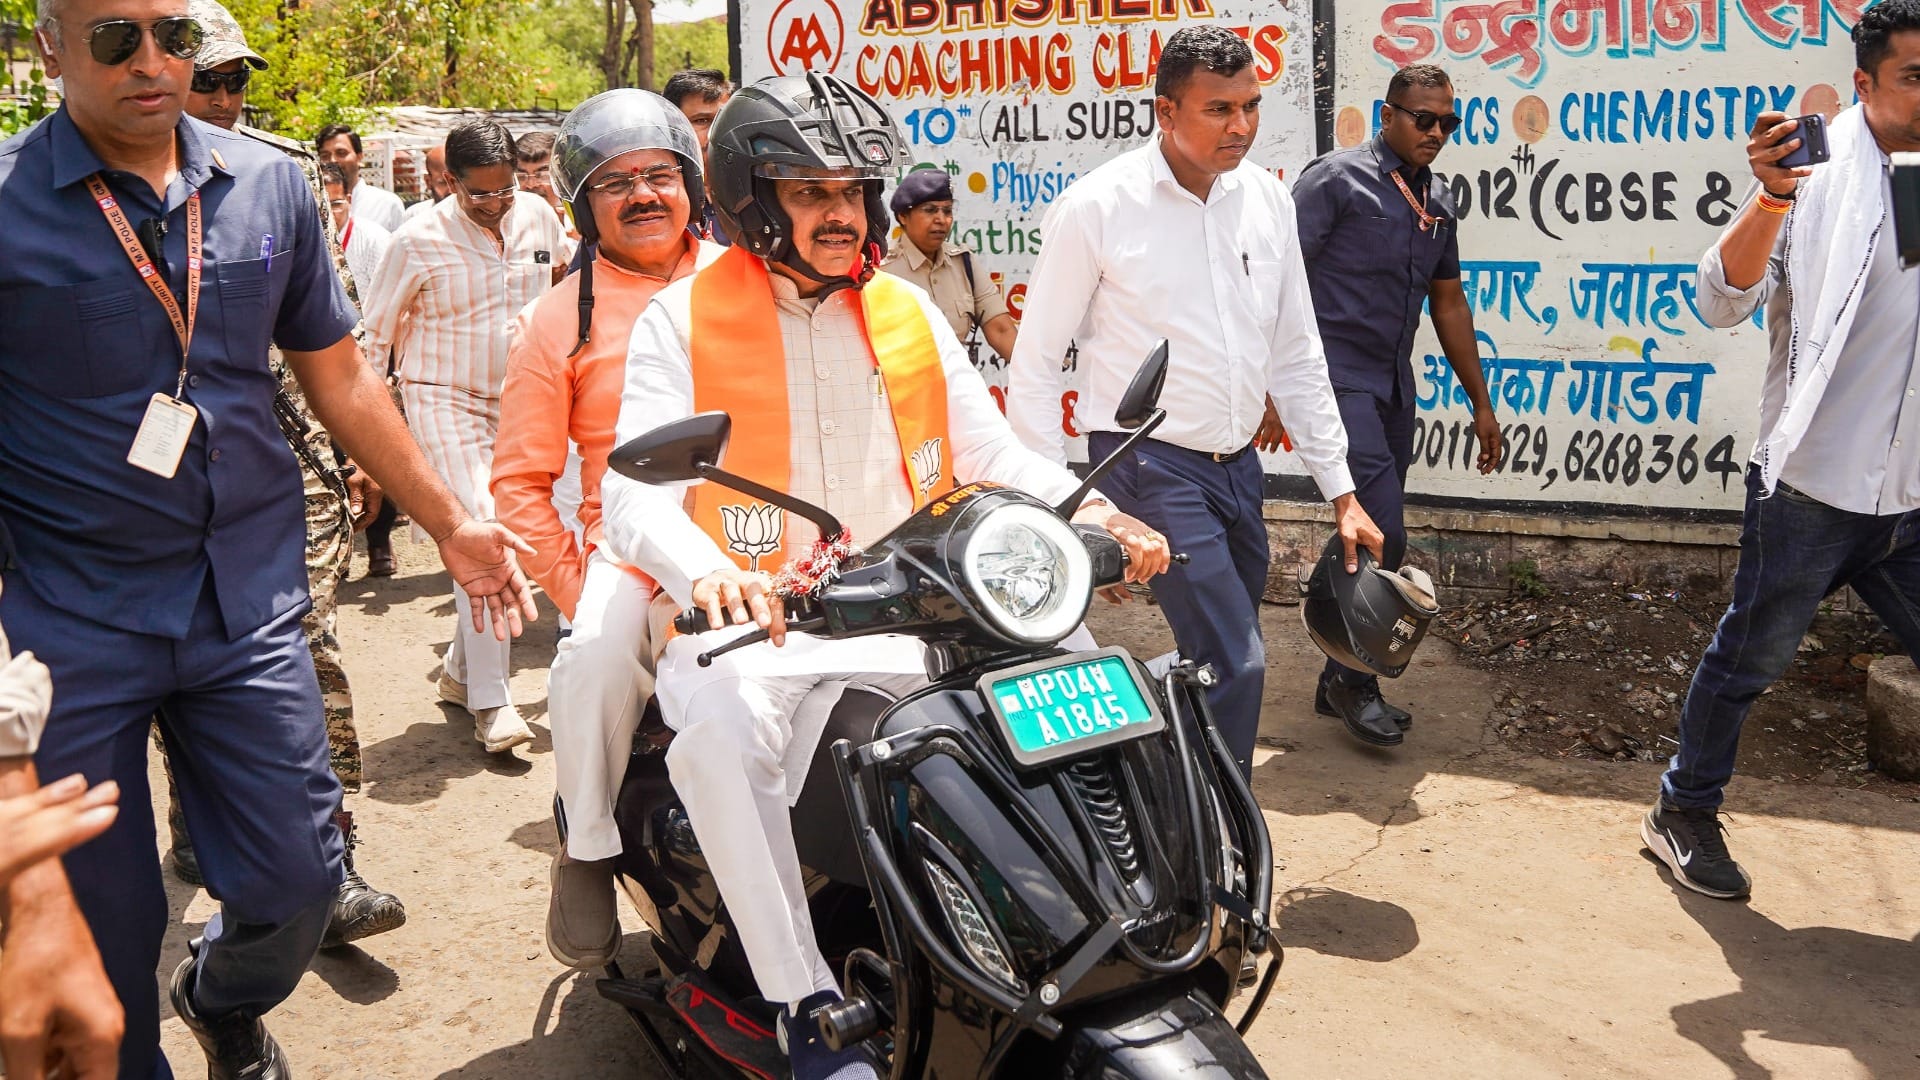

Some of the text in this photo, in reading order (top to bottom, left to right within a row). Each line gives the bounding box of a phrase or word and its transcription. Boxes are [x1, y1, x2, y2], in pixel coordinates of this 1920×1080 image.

[856, 24, 1286, 97] COACHING CLAS
[109, 210, 135, 243] POLICE
[950, 219, 1042, 256] aths
[1567, 337, 1717, 426] गार्डन
[1016, 664, 1112, 711] MP04W
[1035, 695, 1130, 745] A1845
